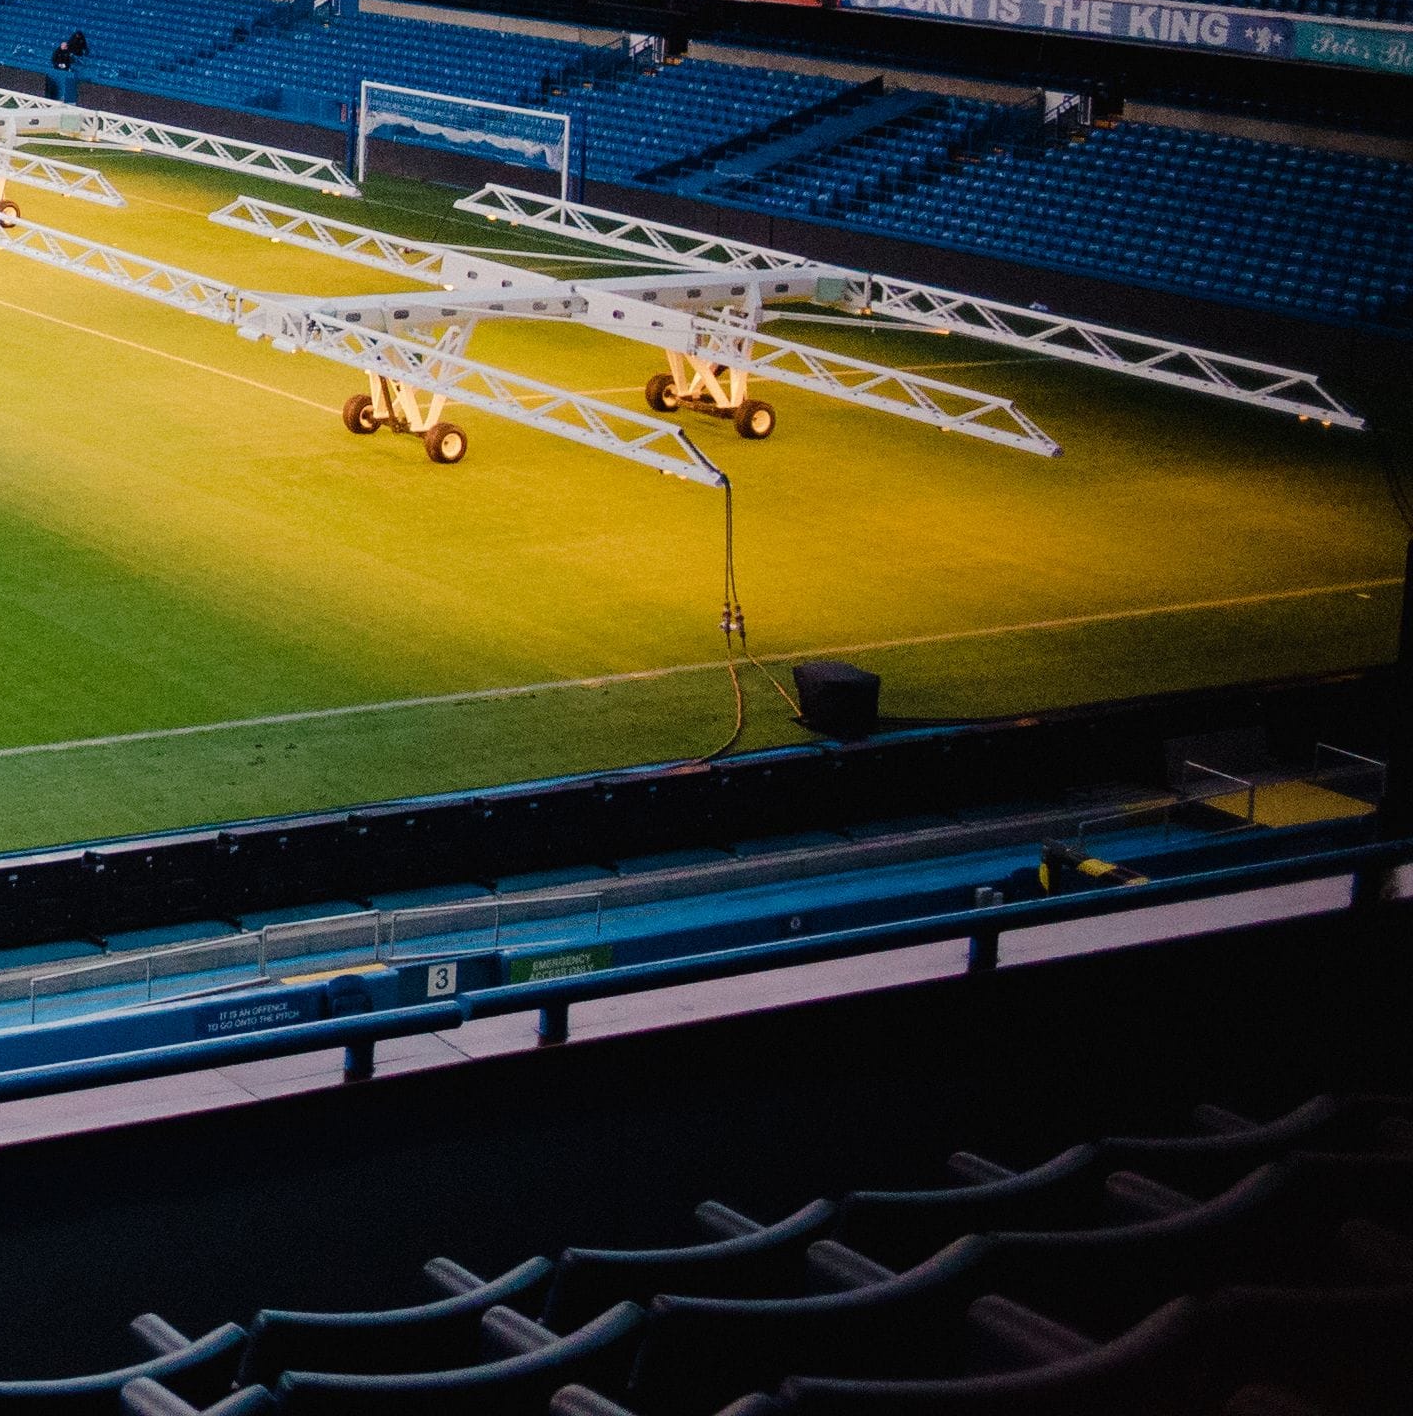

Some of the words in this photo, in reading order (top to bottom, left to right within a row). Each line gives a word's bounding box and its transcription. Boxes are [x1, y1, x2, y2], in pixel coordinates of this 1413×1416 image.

[1128, 5, 1231, 46] KING
[435, 968, 449, 990] 3
[208, 1022, 219, 1032] TO
[220, 1020, 233, 1030] GO
[234, 1017, 258, 1028] ONTO
[259, 1014, 274, 1024] THE
[275, 1009, 301, 1021] PITCH
[219, 1011, 227, 1021] IT
[229, 1010, 238, 1019] IS
[239, 1008, 251, 1018] AN
[253, 1002, 288, 1015] OFFENCE
